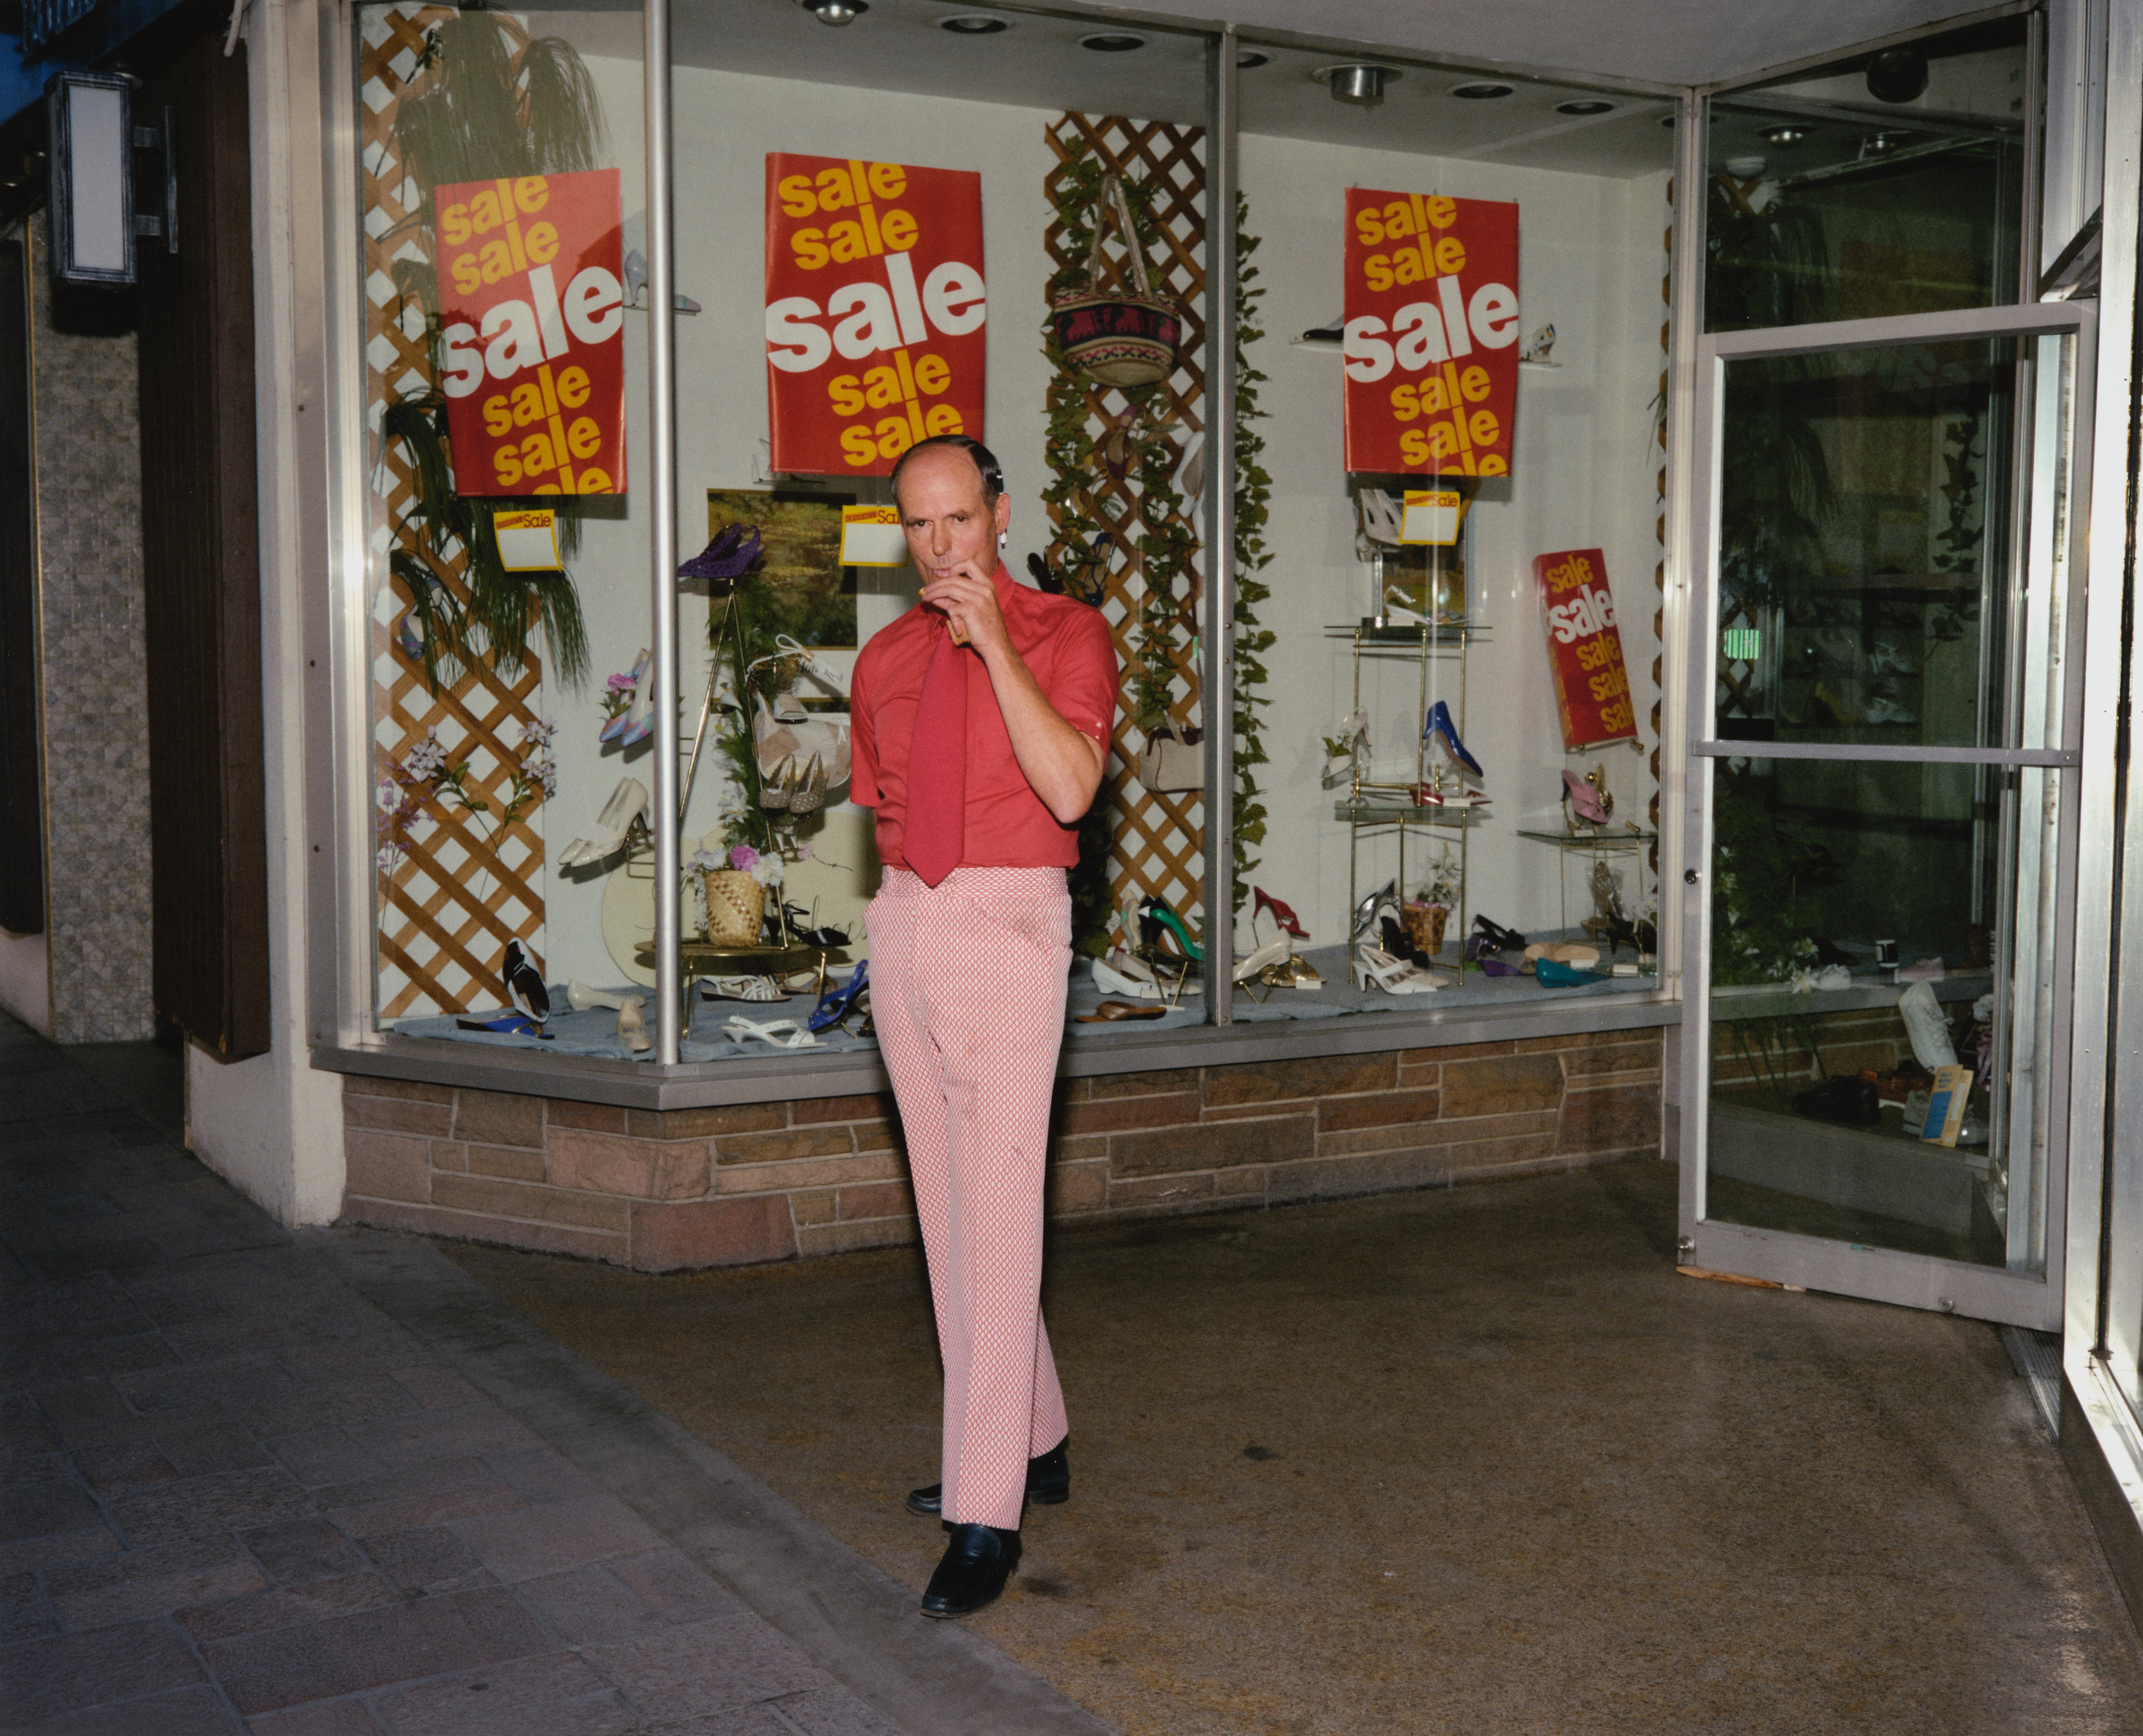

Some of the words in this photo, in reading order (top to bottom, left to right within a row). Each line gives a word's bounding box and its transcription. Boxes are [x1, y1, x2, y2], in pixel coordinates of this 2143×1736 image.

[441, 175, 549, 246] sale
[778, 158, 907, 218] sale
[790, 203, 919, 271] sale
[1355, 193, 1457, 246] sale
[451, 219, 560, 296] sale
[1363, 231, 1466, 292] sale
[440, 263, 623, 398] sale
[765, 251, 987, 373] sale
[1344, 274, 1519, 384] sale
[482, 363, 591, 438] sale
[828, 348, 951, 417] sale
[1390, 362, 1491, 421] sale
[493, 413, 601, 487] sale
[839, 399, 963, 467] sale
[1399, 405, 1500, 466] sale
[523, 513, 552, 528] Sale
[877, 509, 901, 524] Sal
[1431, 493, 1458, 507] Sale
[1546, 555, 1594, 594] sale
[1549, 583, 1617, 644] sale
[1575, 631, 1621, 672] sale
[1599, 694, 1637, 733] sal
